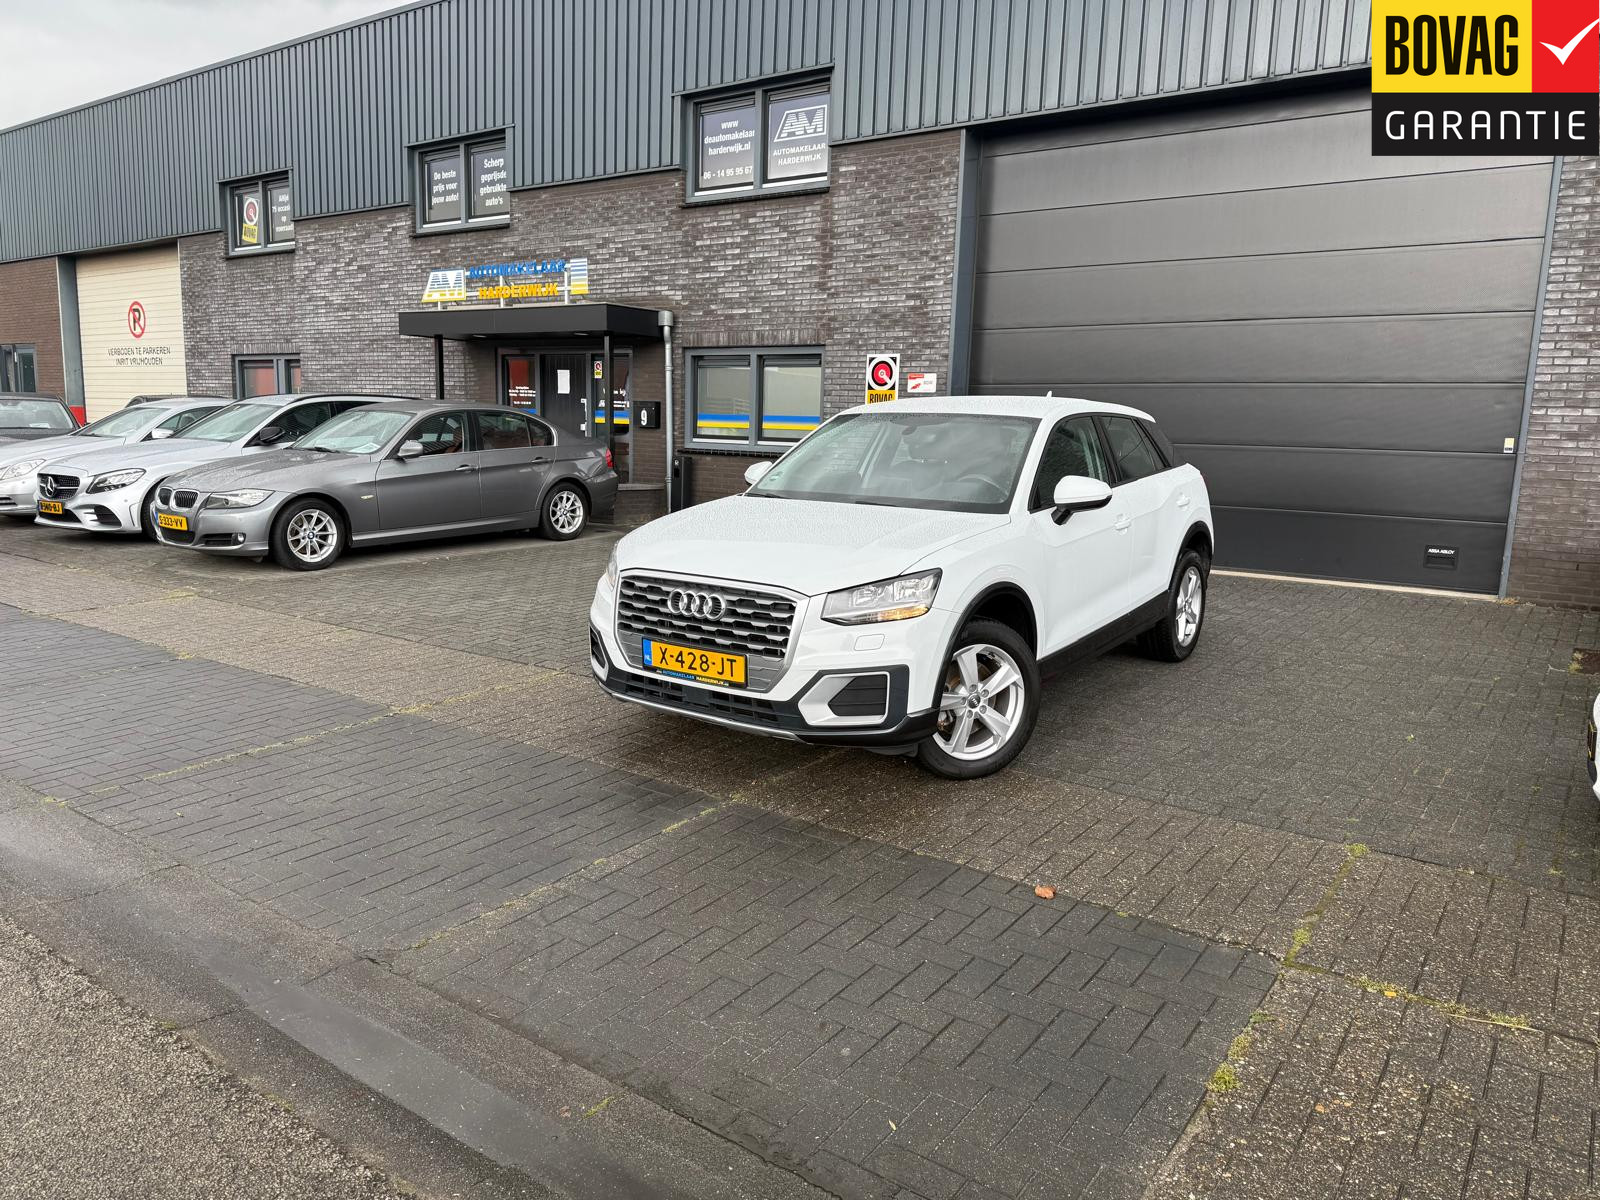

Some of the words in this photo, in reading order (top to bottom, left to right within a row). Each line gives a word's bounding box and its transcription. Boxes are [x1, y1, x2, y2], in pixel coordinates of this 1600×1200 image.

[779, 108, 824, 139] AM
[704, 130, 755, 144] deautomakelaar
[708, 141, 751, 156] harderwijk.nl
[773, 143, 826, 156] AUTOMAKELAAR
[484, 158, 504, 168] Scherp
[778, 153, 821, 166] HARDERWIJK
[433, 172, 441, 180] De
[442, 170, 456, 179] beste
[703, 171, 712, 179] 06
[717, 169, 725, 177] 14
[726, 168, 734, 177] 95
[735, 167, 744, 176] 95
[745, 166, 753, 174] 67
[433, 184, 445, 193] prijs
[446, 182, 458, 190] voor
[432, 196, 445, 205] jouw
[445, 193, 459, 202] auto!
[485, 196, 504, 206] auto's
[467, 259, 567, 279] AUTOMAKELAAR
[426, 271, 463, 298] AM
[479, 283, 559, 299] HARDERWIJK
[107, 347, 135, 356] VERBODEN
[135, 347, 142, 355] TE
[142, 346, 171, 355] PARKEREN
[116, 357, 129, 365] INRIT
[640, 409, 648, 426] 9
[158, 514, 183, 528] S-333-VV
[659, 646, 737, 678] X-428-JT
